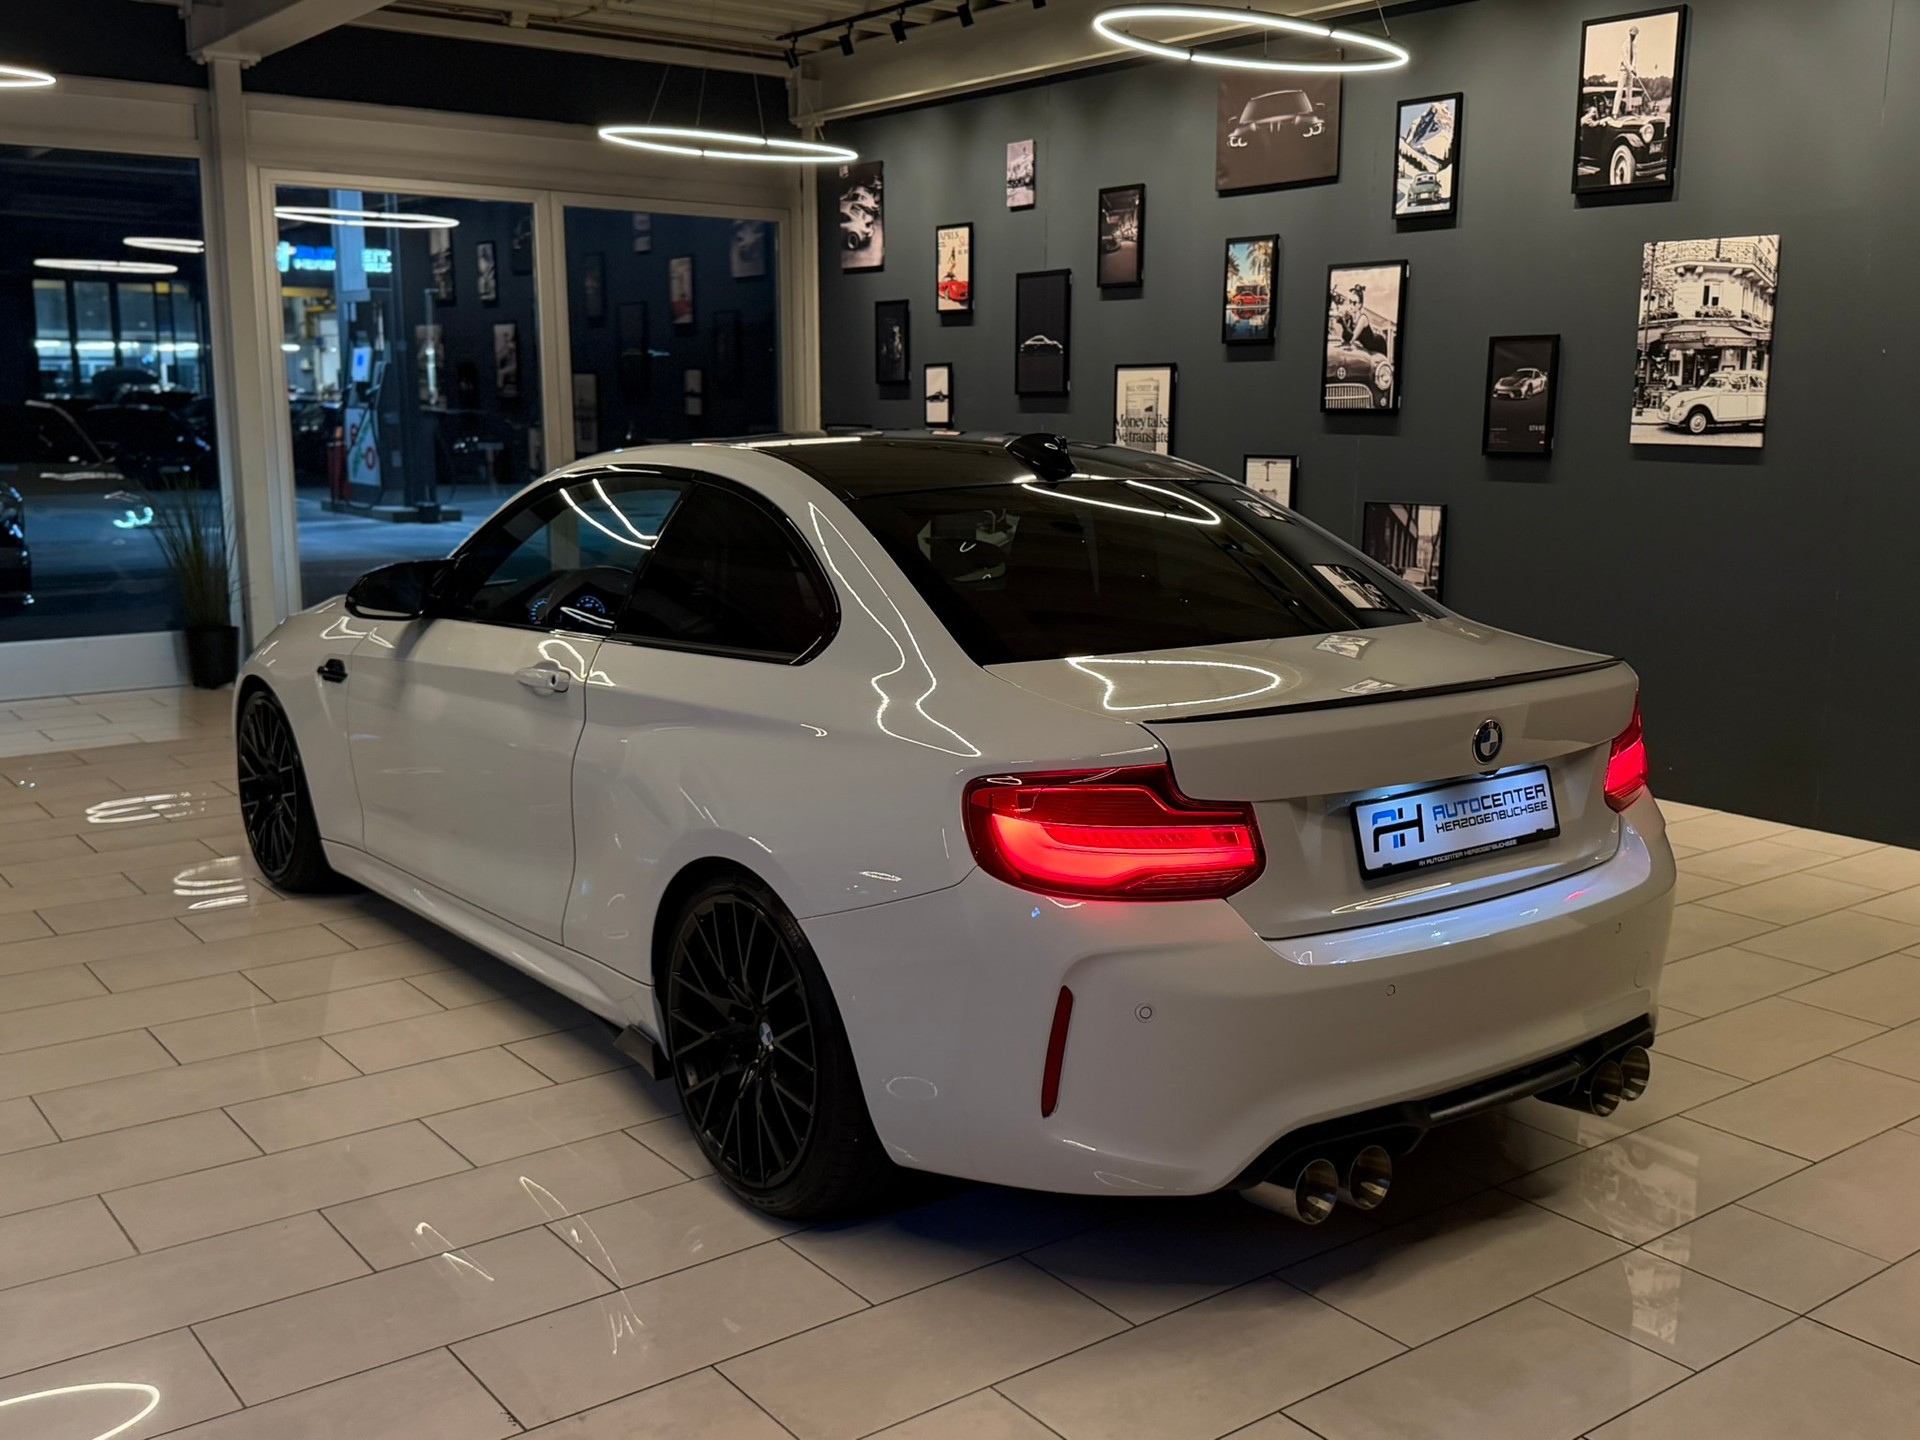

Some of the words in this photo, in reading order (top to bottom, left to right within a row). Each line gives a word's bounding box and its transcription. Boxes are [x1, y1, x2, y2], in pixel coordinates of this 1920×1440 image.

[1432, 783, 1546, 820] AUTOCENTER
[1435, 801, 1548, 833] HERZOGENBUCHSEE
[1372, 803, 1425, 853] AH
